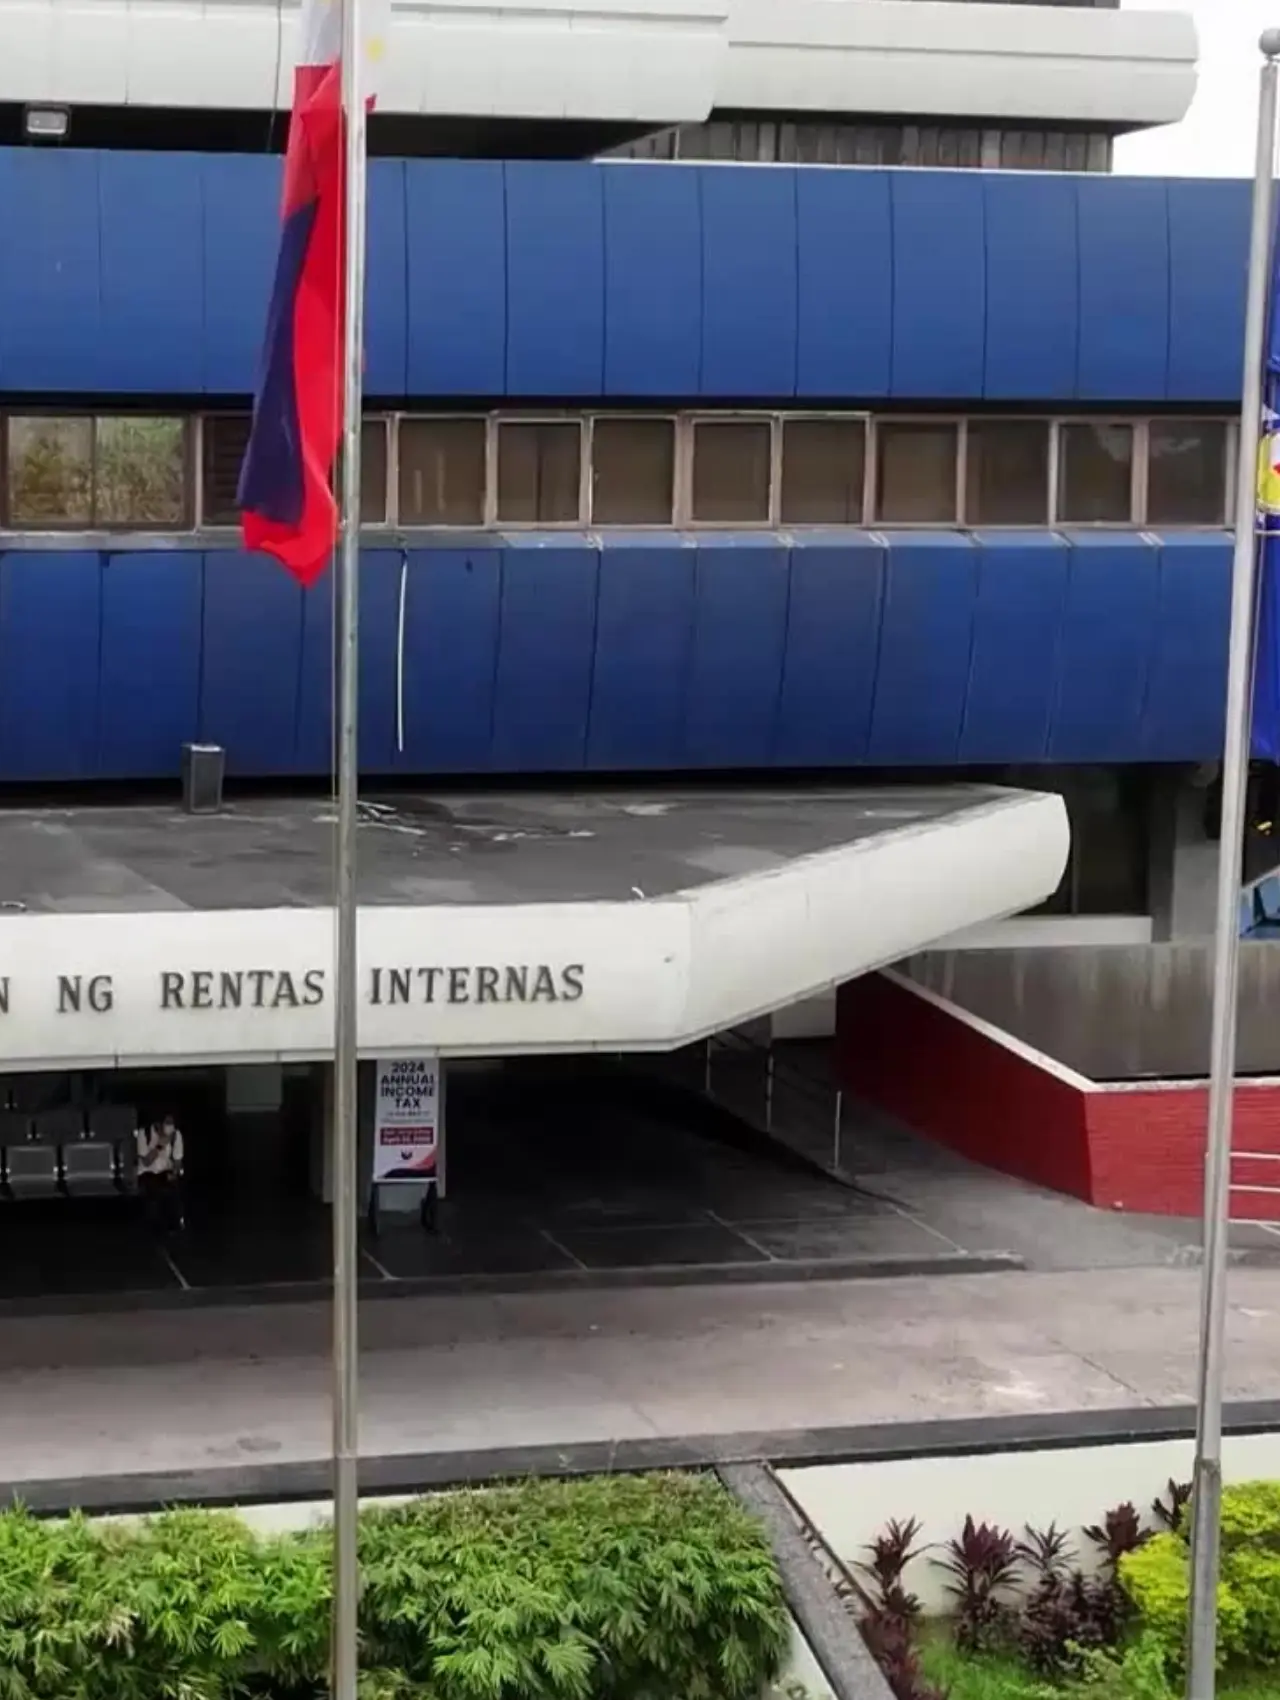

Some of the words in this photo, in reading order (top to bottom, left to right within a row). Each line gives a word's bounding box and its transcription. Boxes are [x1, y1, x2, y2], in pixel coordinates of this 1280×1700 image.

[57, 975, 114, 1013] NG
[160, 969, 325, 1009] RENTAS
[370, 964, 584, 1005] INTERNAS
[391, 1061, 425, 1073] 2024
[381, 1074, 434, 1085] ANNUAL
[381, 1086, 433, 1097] INCOME
[395, 1098, 421, 1109] TAX
